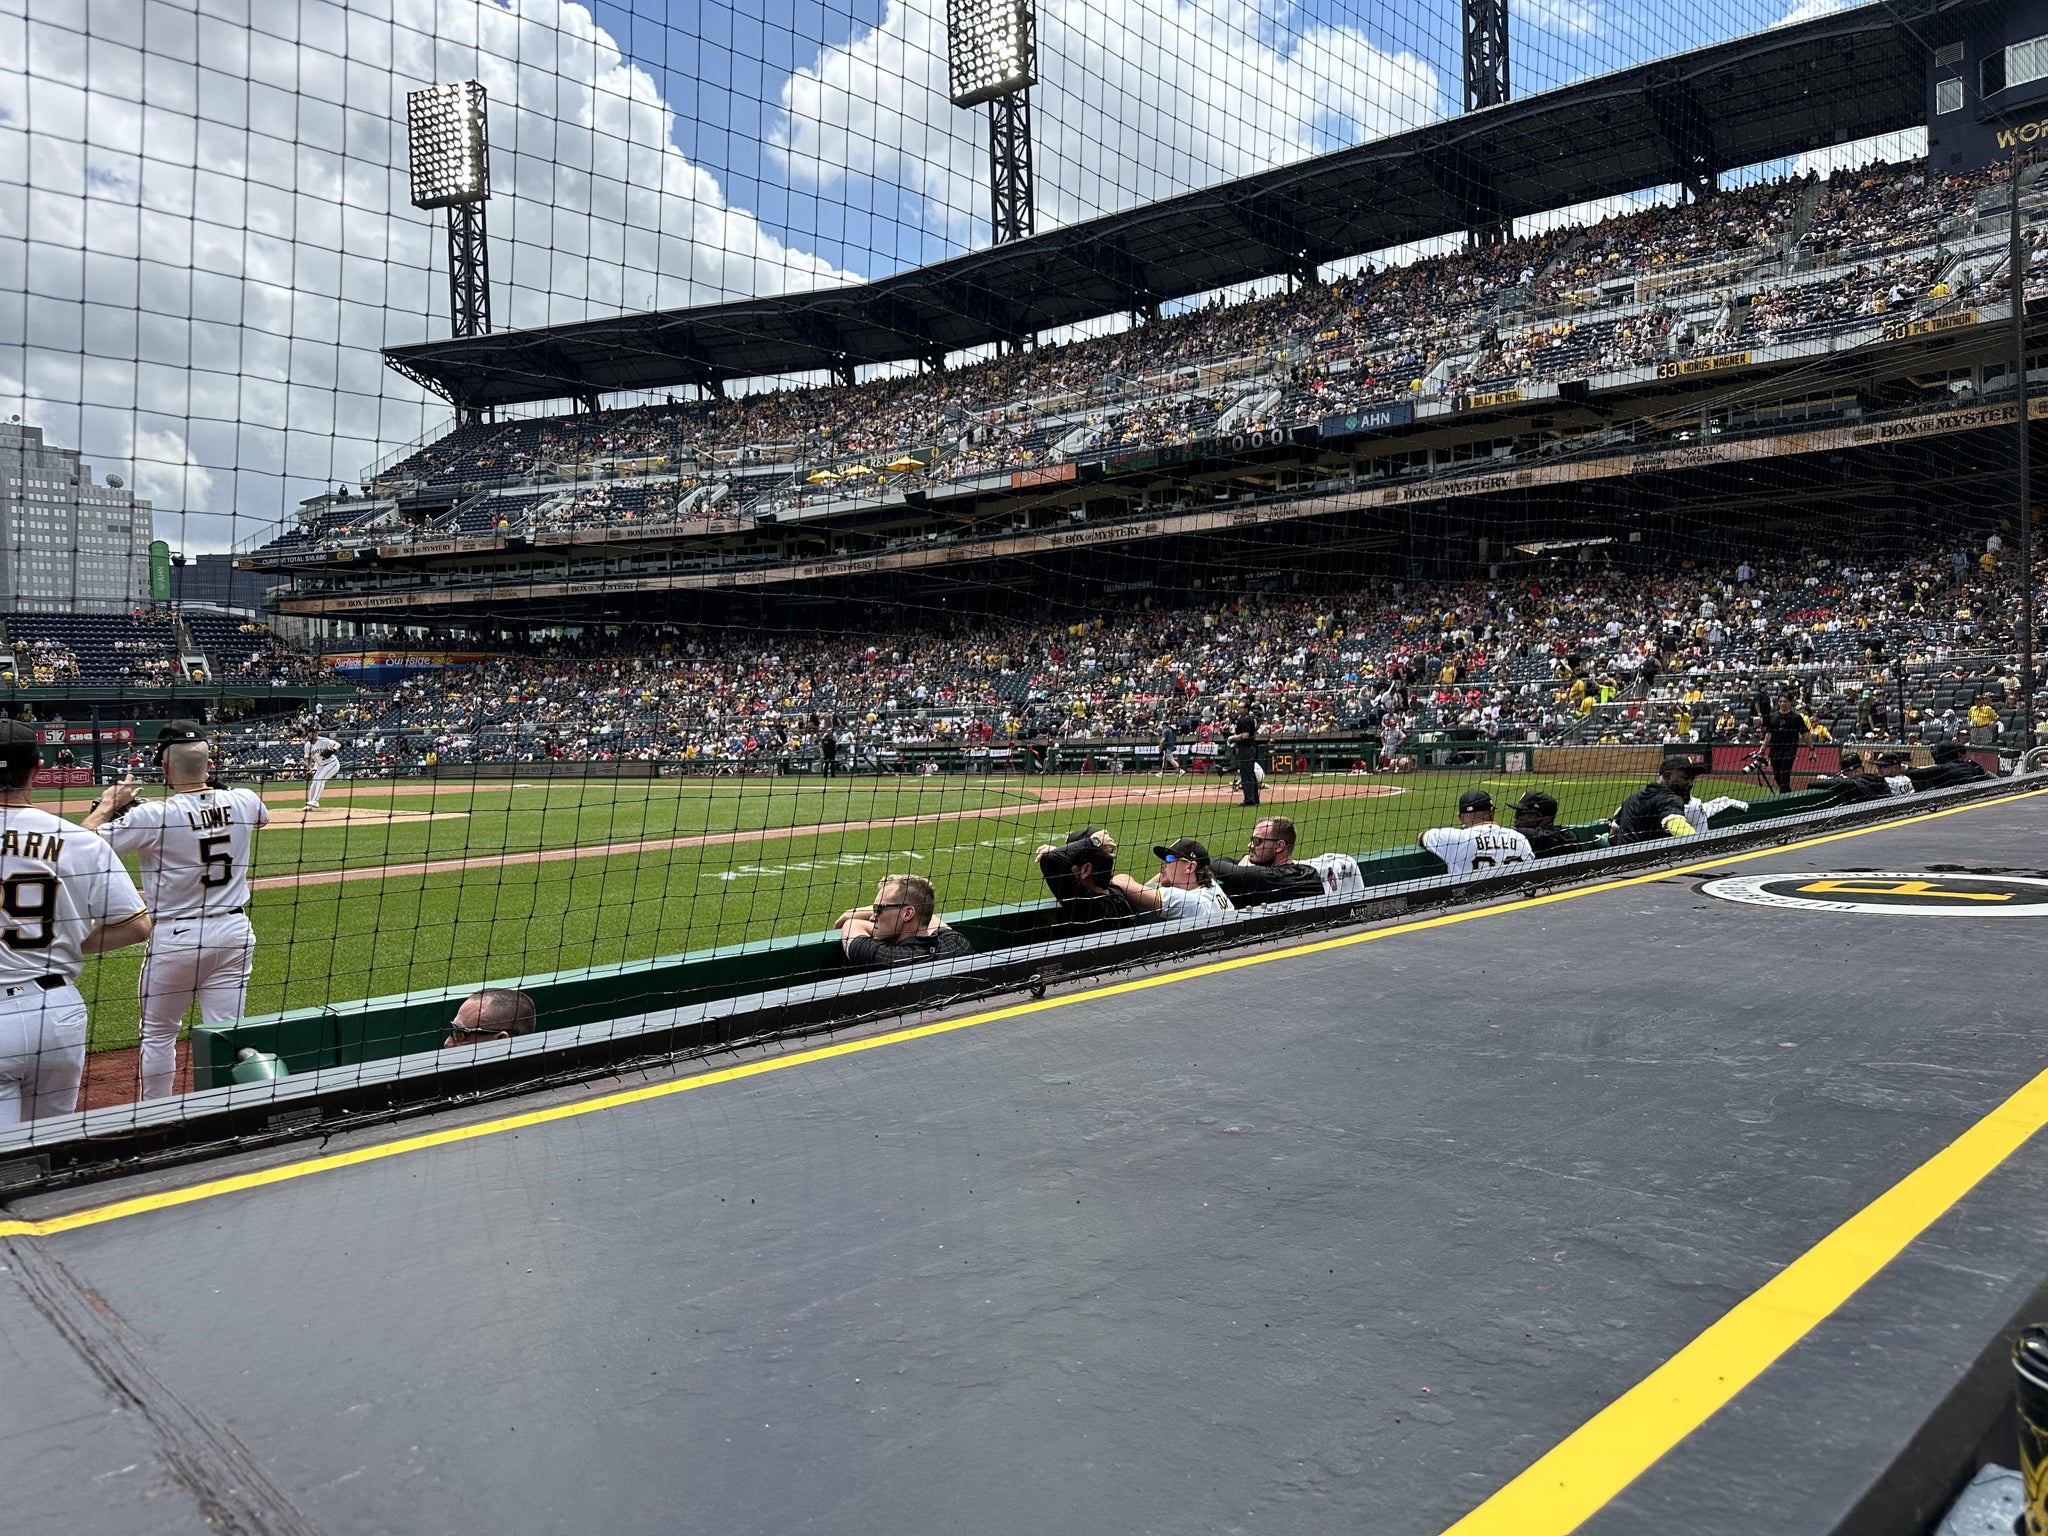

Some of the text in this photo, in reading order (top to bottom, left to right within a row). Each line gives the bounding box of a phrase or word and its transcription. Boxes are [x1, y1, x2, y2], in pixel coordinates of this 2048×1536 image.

[1914, 320, 1928, 332] PIE
[1932, 312, 1970, 329] TRAYNOR
[1659, 354, 1746, 379] 33 HONUS WAGNER
[1474, 396, 1492, 406] BILLY
[1496, 392, 1517, 404] MEYER
[1360, 412, 1390, 428] AHN
[1880, 422, 1919, 438] BOX
[1936, 406, 2019, 430] MYSTER
[1046, 466, 1068, 476] BANK
[1404, 487, 1430, 499] BOX
[1444, 476, 1510, 494] MYSTERY
[650, 526, 684, 536] MYSTERY
[1066, 534, 1084, 544] BOX
[1094, 526, 1140, 540] MYSTERY
[369, 597, 404, 606] MYSTERY
[386, 653, 430, 667] Surfside
[46, 730, 64, 740] 57
[187, 806, 232, 832] LOWE
[2, 829, 65, 863] ARN
[1475, 836, 1517, 850] BELLO
[198, 834, 234, 889] 5
[0, 872, 62, 950] 9
